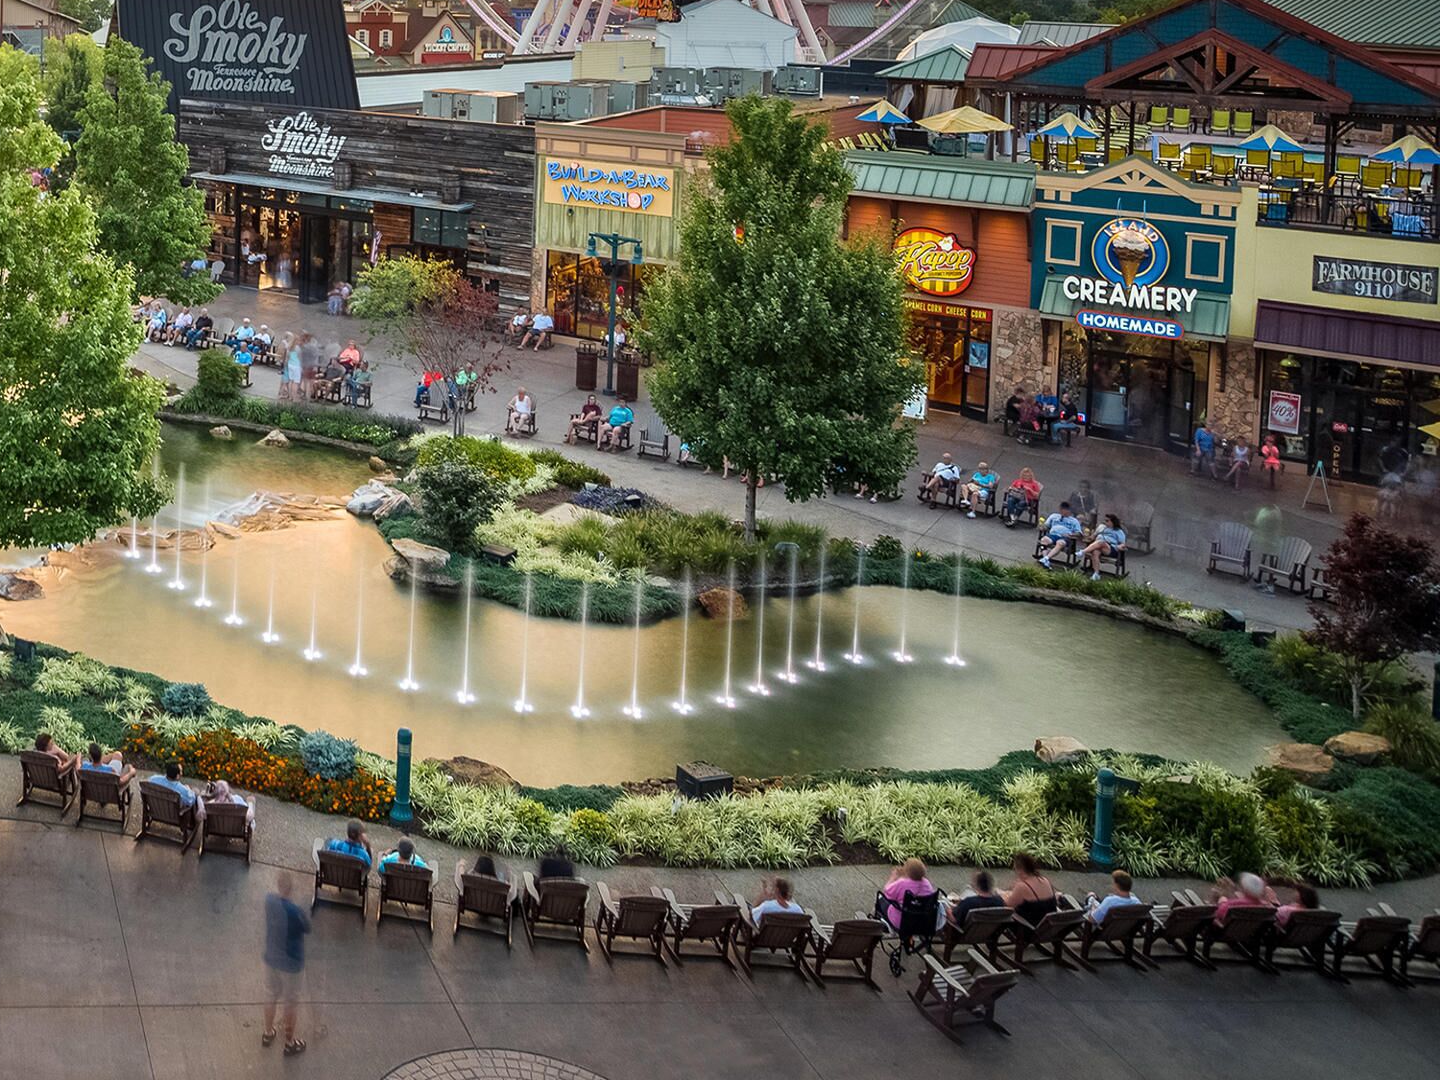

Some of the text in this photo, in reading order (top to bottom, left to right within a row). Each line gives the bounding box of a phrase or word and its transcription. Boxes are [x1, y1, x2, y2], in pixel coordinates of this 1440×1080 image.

[163, 5, 307, 74] Smoky
[187, 67, 295, 93] Moonshine
[213, 63, 258, 76] Tennessee
[294, 112, 321, 134] Ole
[261, 116, 347, 163] Smoky
[268, 154, 335, 178] Moonshine
[561, 184, 654, 210] WORKSHOP
[1104, 220, 1159, 242] ISLAND
[894, 242, 972, 277] Kapop
[1317, 261, 1433, 297] FARMHOUSE
[1354, 281, 1393, 299] 9110
[1063, 275, 1198, 313] CREAMERY
[927, 303, 942, 313] CORN
[946, 306, 967, 317] CHEESE
[971, 309, 987, 319] CORN
[1082, 313, 1176, 337] HOMEMADE
[1272, 404, 1296, 421] 40%
